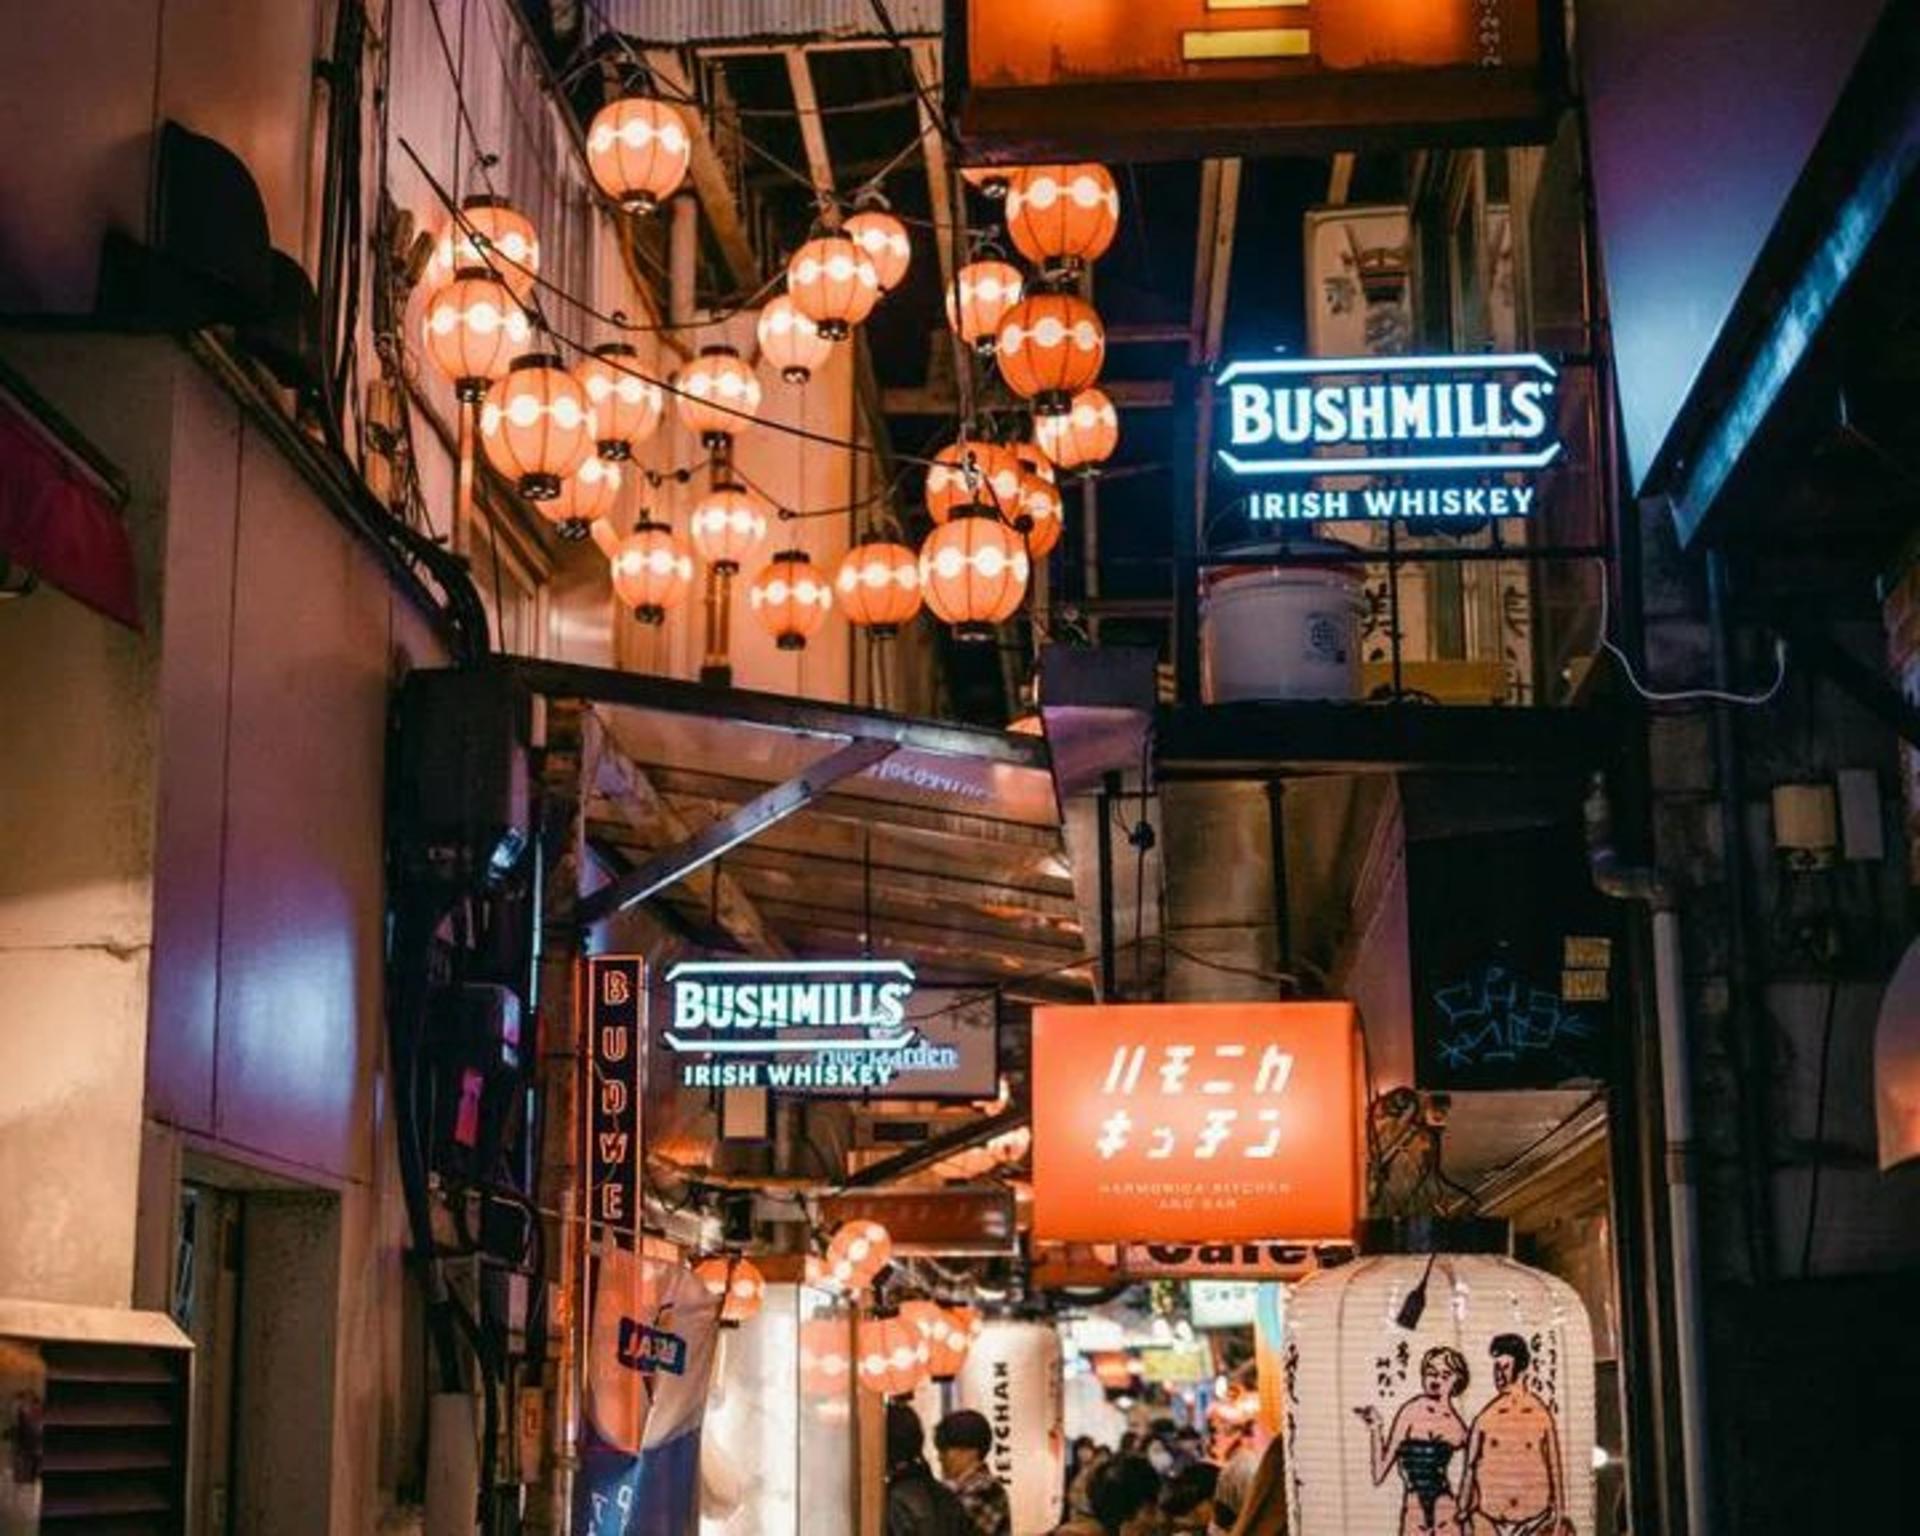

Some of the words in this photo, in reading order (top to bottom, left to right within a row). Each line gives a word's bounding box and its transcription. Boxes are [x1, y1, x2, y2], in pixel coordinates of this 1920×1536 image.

[1231, 382, 1554, 445] BUSHMILLS
[1250, 490, 1349, 520] IRISH
[1363, 487, 1534, 517] WHISKEY
[674, 981, 912, 1029] BUSHMILLS
[684, 1065, 757, 1087] IRISH
[767, 1064, 893, 1086] WHISKEY
[1103, 1043, 1294, 1095] ハモニカ
[1096, 1108, 1281, 1160] キッチン
